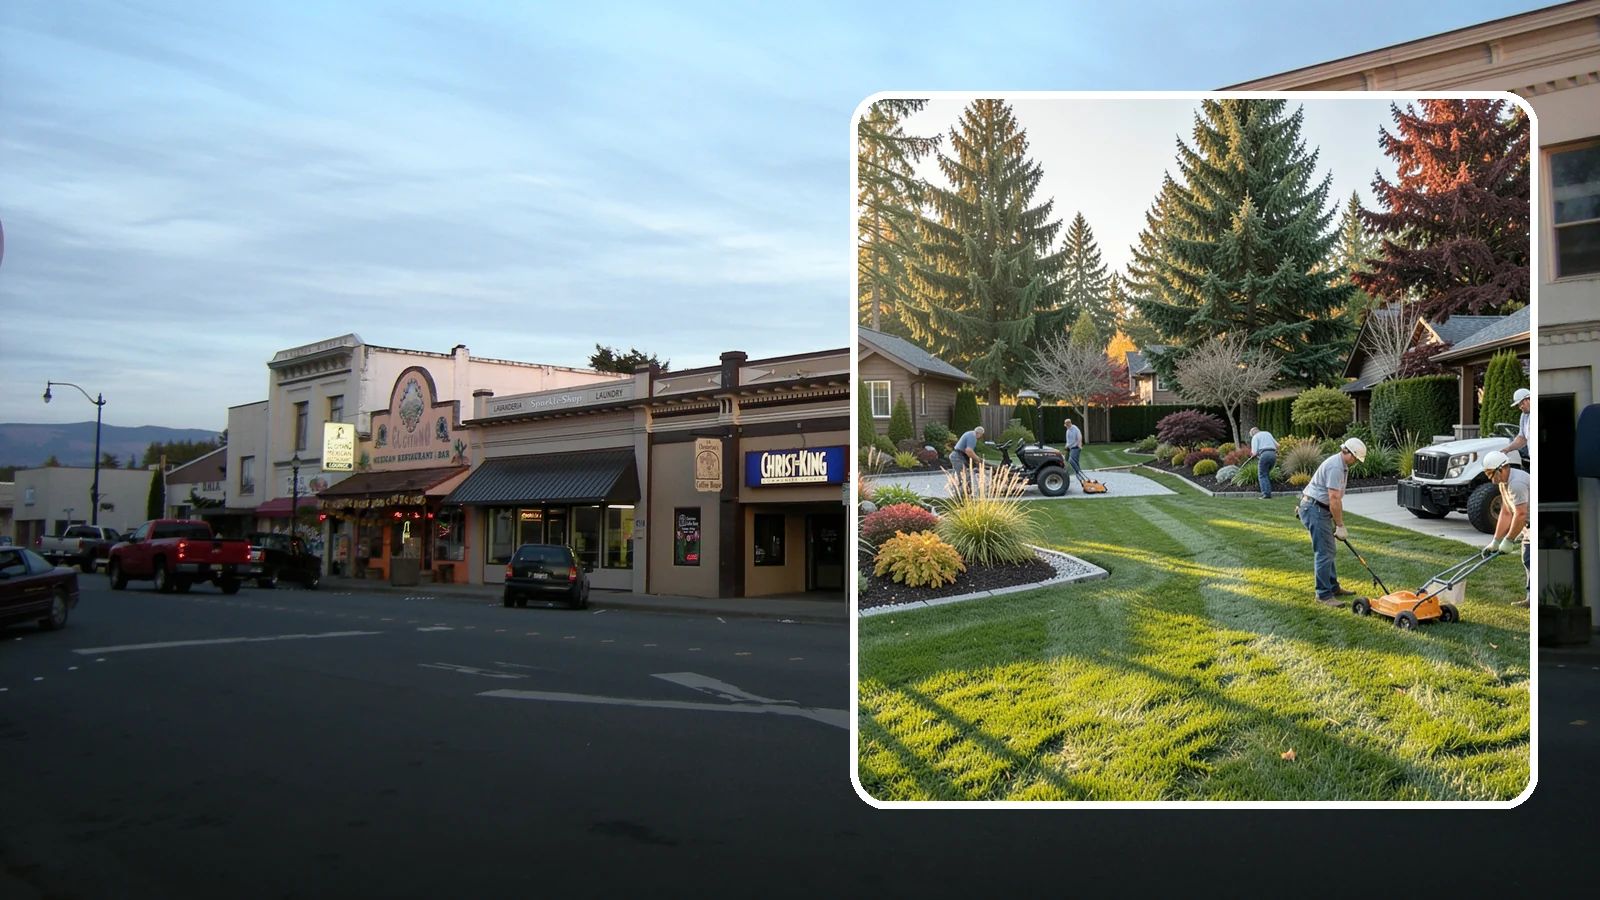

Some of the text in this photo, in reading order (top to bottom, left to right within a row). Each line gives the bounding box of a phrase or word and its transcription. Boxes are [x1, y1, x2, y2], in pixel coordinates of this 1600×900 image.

[596, 389, 623, 399] LAUNDRY
[494, 402, 522, 412] LAVANDERIA
[531, 395, 582, 408] Sparkle Shop
[374, 455, 396, 464] MEXICAN
[398, 451, 433, 462] RESTAURANT
[438, 450, 450, 459] BAR
[761, 450, 827, 478] CHRIST KING
